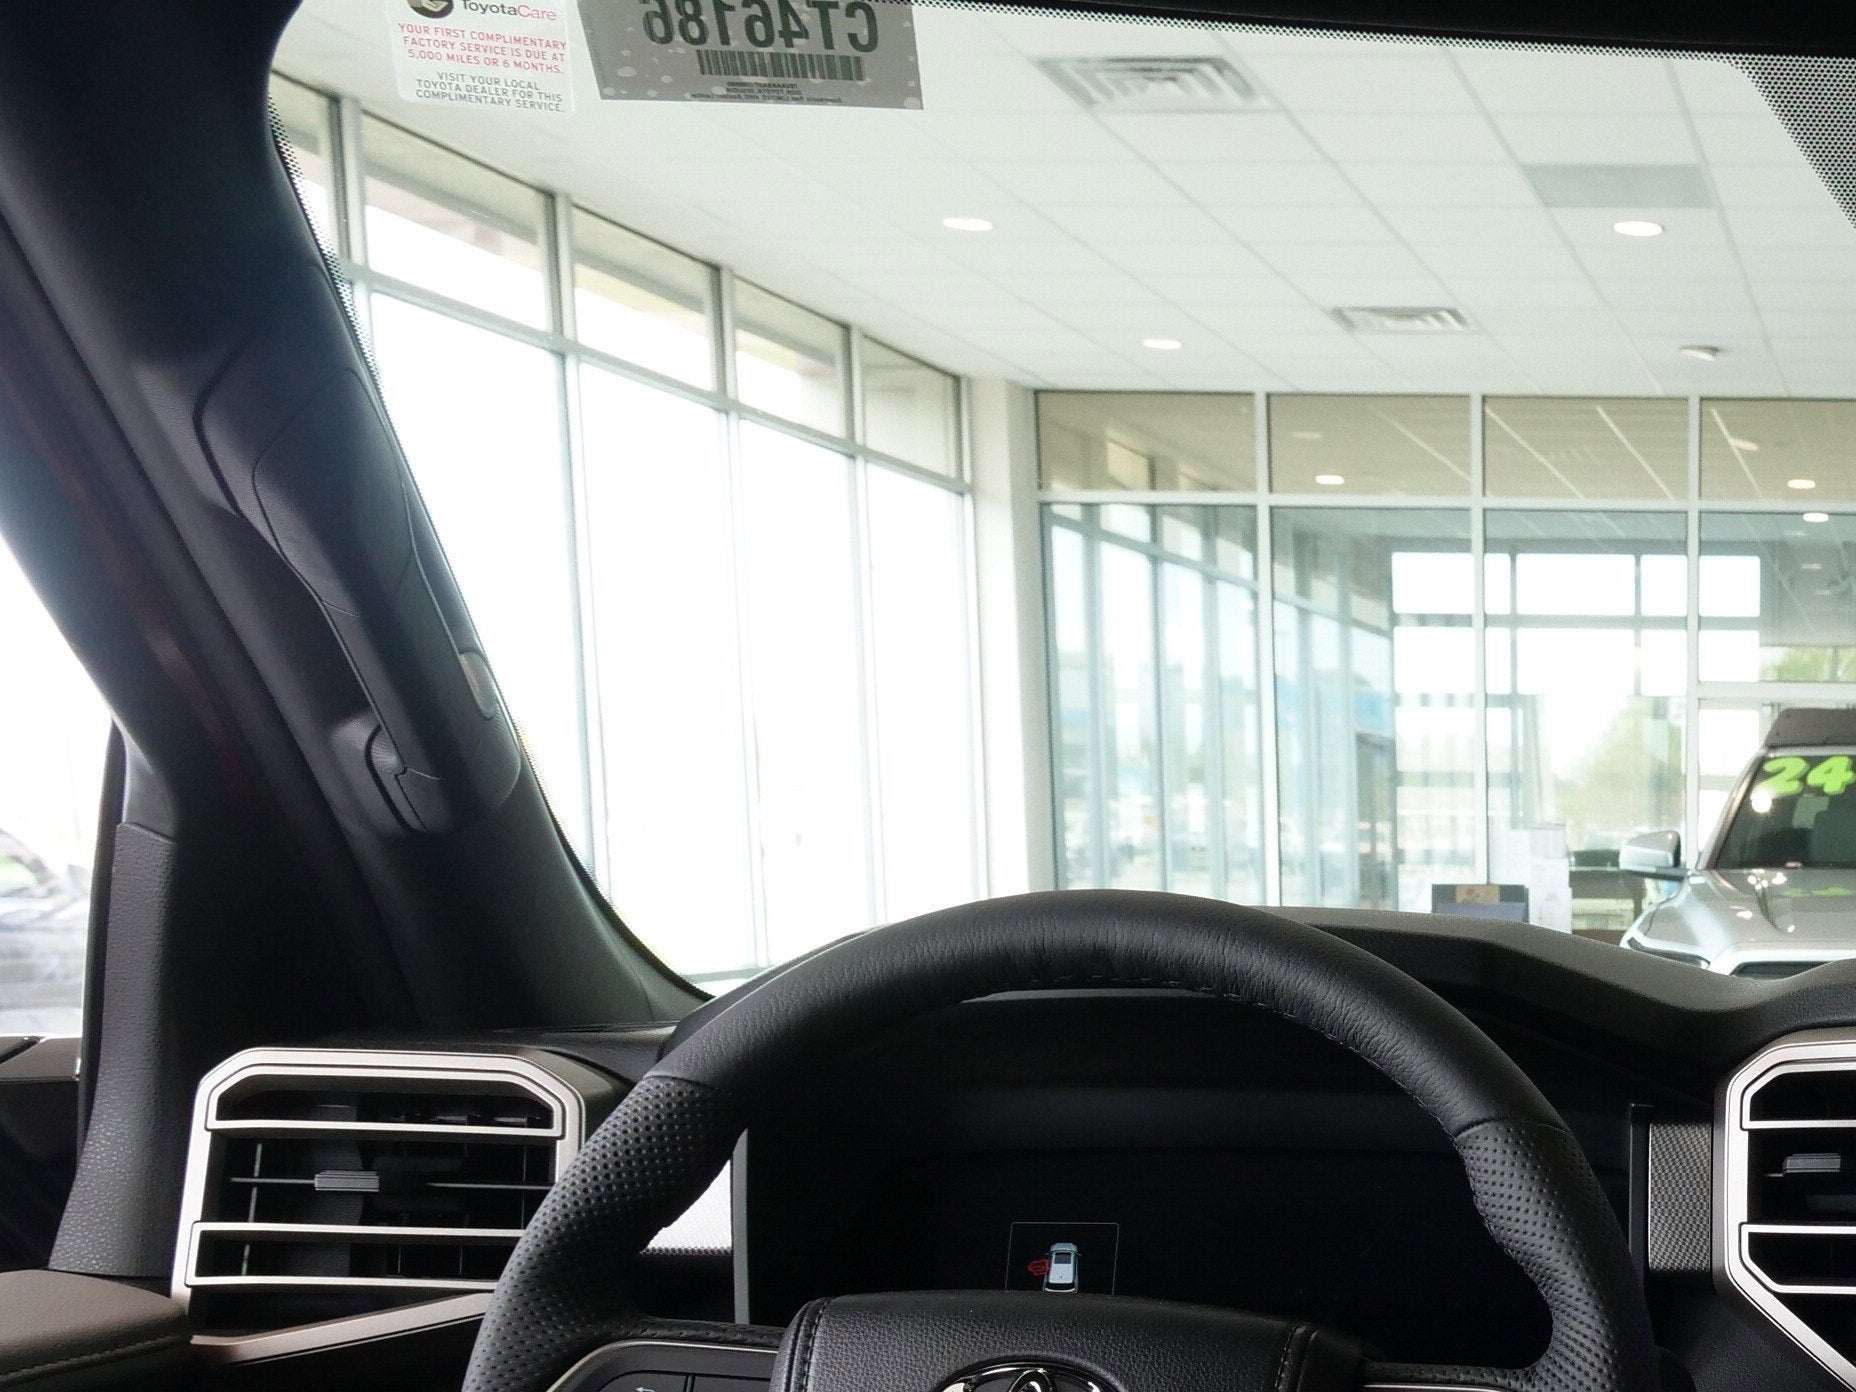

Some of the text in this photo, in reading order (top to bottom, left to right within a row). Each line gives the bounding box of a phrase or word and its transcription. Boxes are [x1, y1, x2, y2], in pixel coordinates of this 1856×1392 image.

[463, 0, 557, 21] ToyotaCare
[399, 23, 567, 49] YOUR FIRST COMPLIMENTARY
[403, 36, 565, 62] FACTORY SERVICE IS DUE AT
[446, 53, 480, 65] MILES
[484, 57, 499, 66] OR
[503, 60, 510, 68] 6
[514, 61, 564, 74] MONTHS.
[416, 79, 563, 102] TOYOTA DEALER FOR THIS
[436, 71, 540, 91] VISIT YOUR LOCAL
[416, 89, 566, 112] COMPLIMENTARY SERVICE.
[1759, 755, 1856, 796] 24
